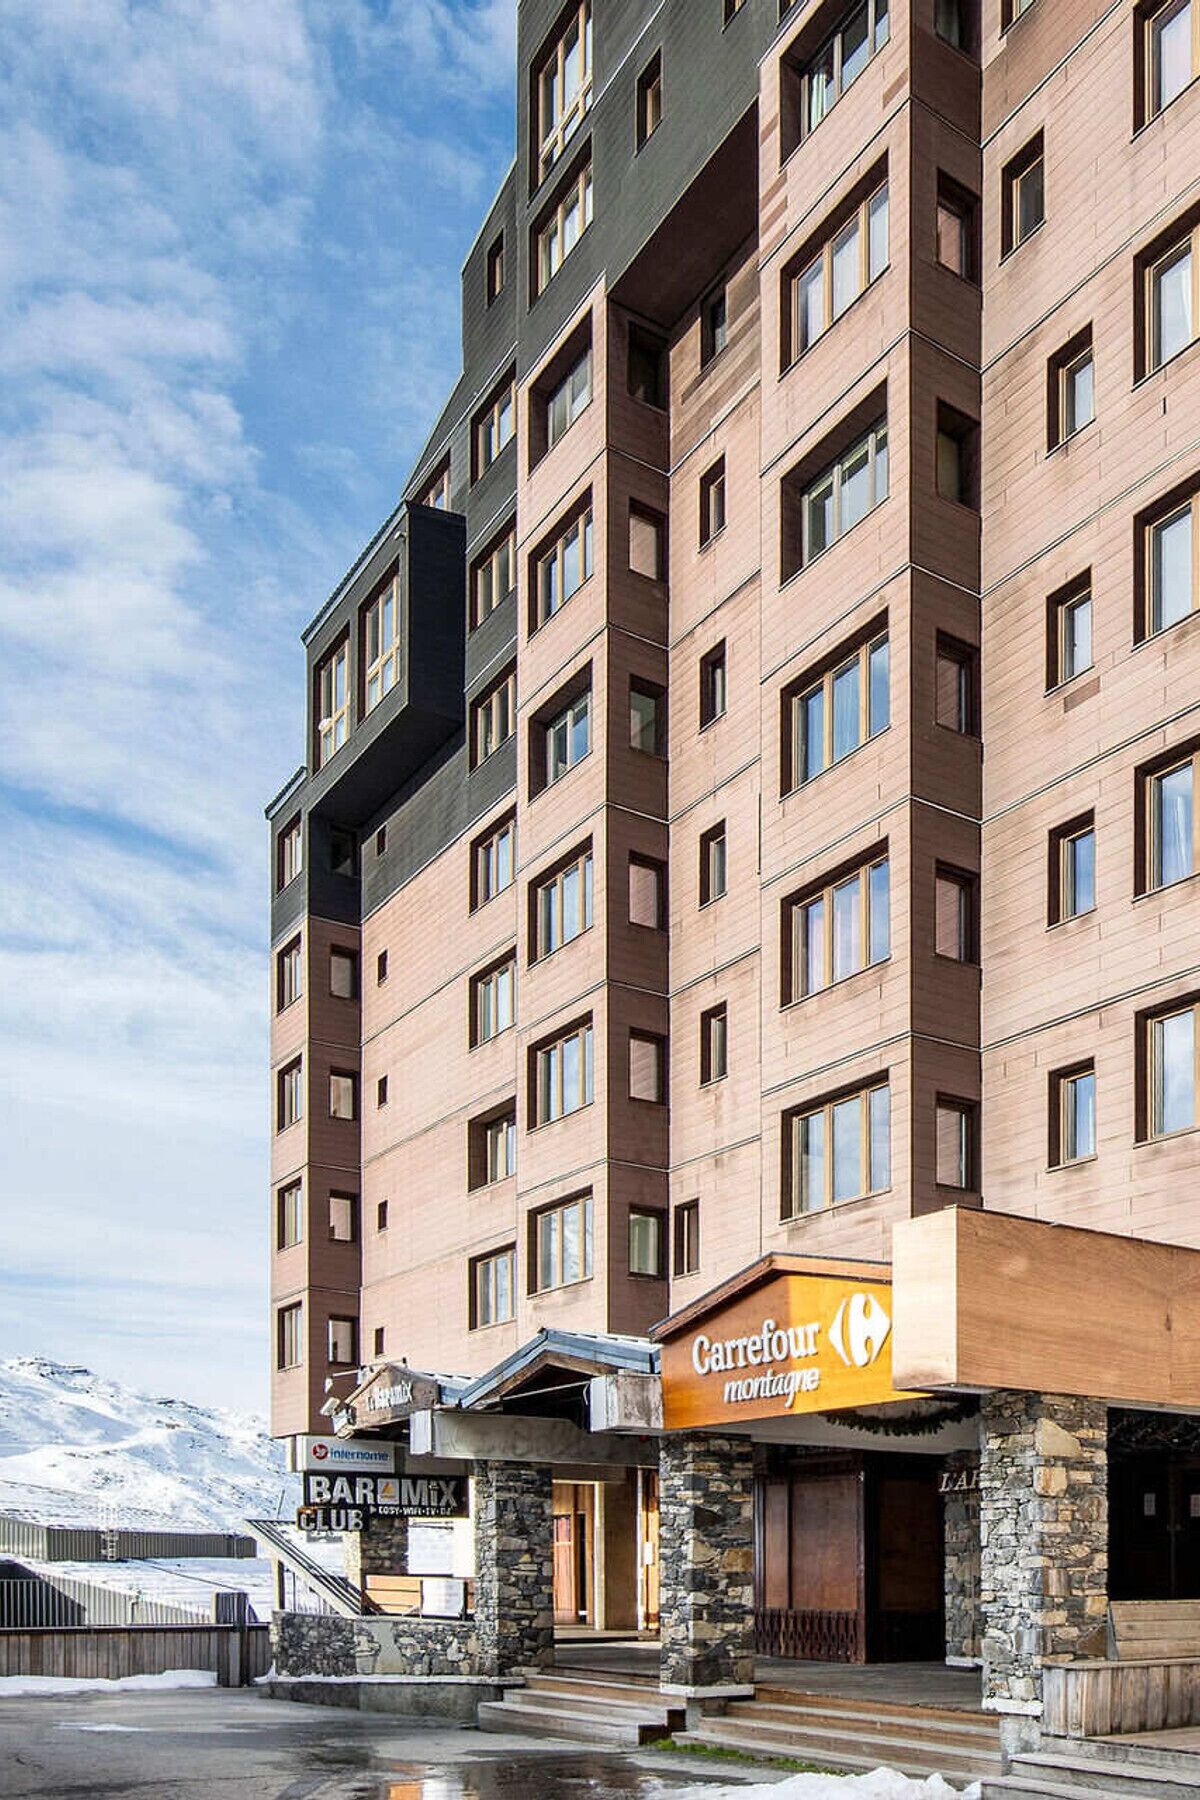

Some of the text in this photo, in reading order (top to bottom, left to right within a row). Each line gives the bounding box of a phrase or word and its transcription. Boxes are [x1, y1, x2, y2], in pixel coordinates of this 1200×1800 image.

[692, 1318, 821, 1376] Carrefour
[723, 1367, 820, 1409] montagne
[309, 1475, 375, 1505] BAR
[300, 1509, 364, 1531] CLUB
